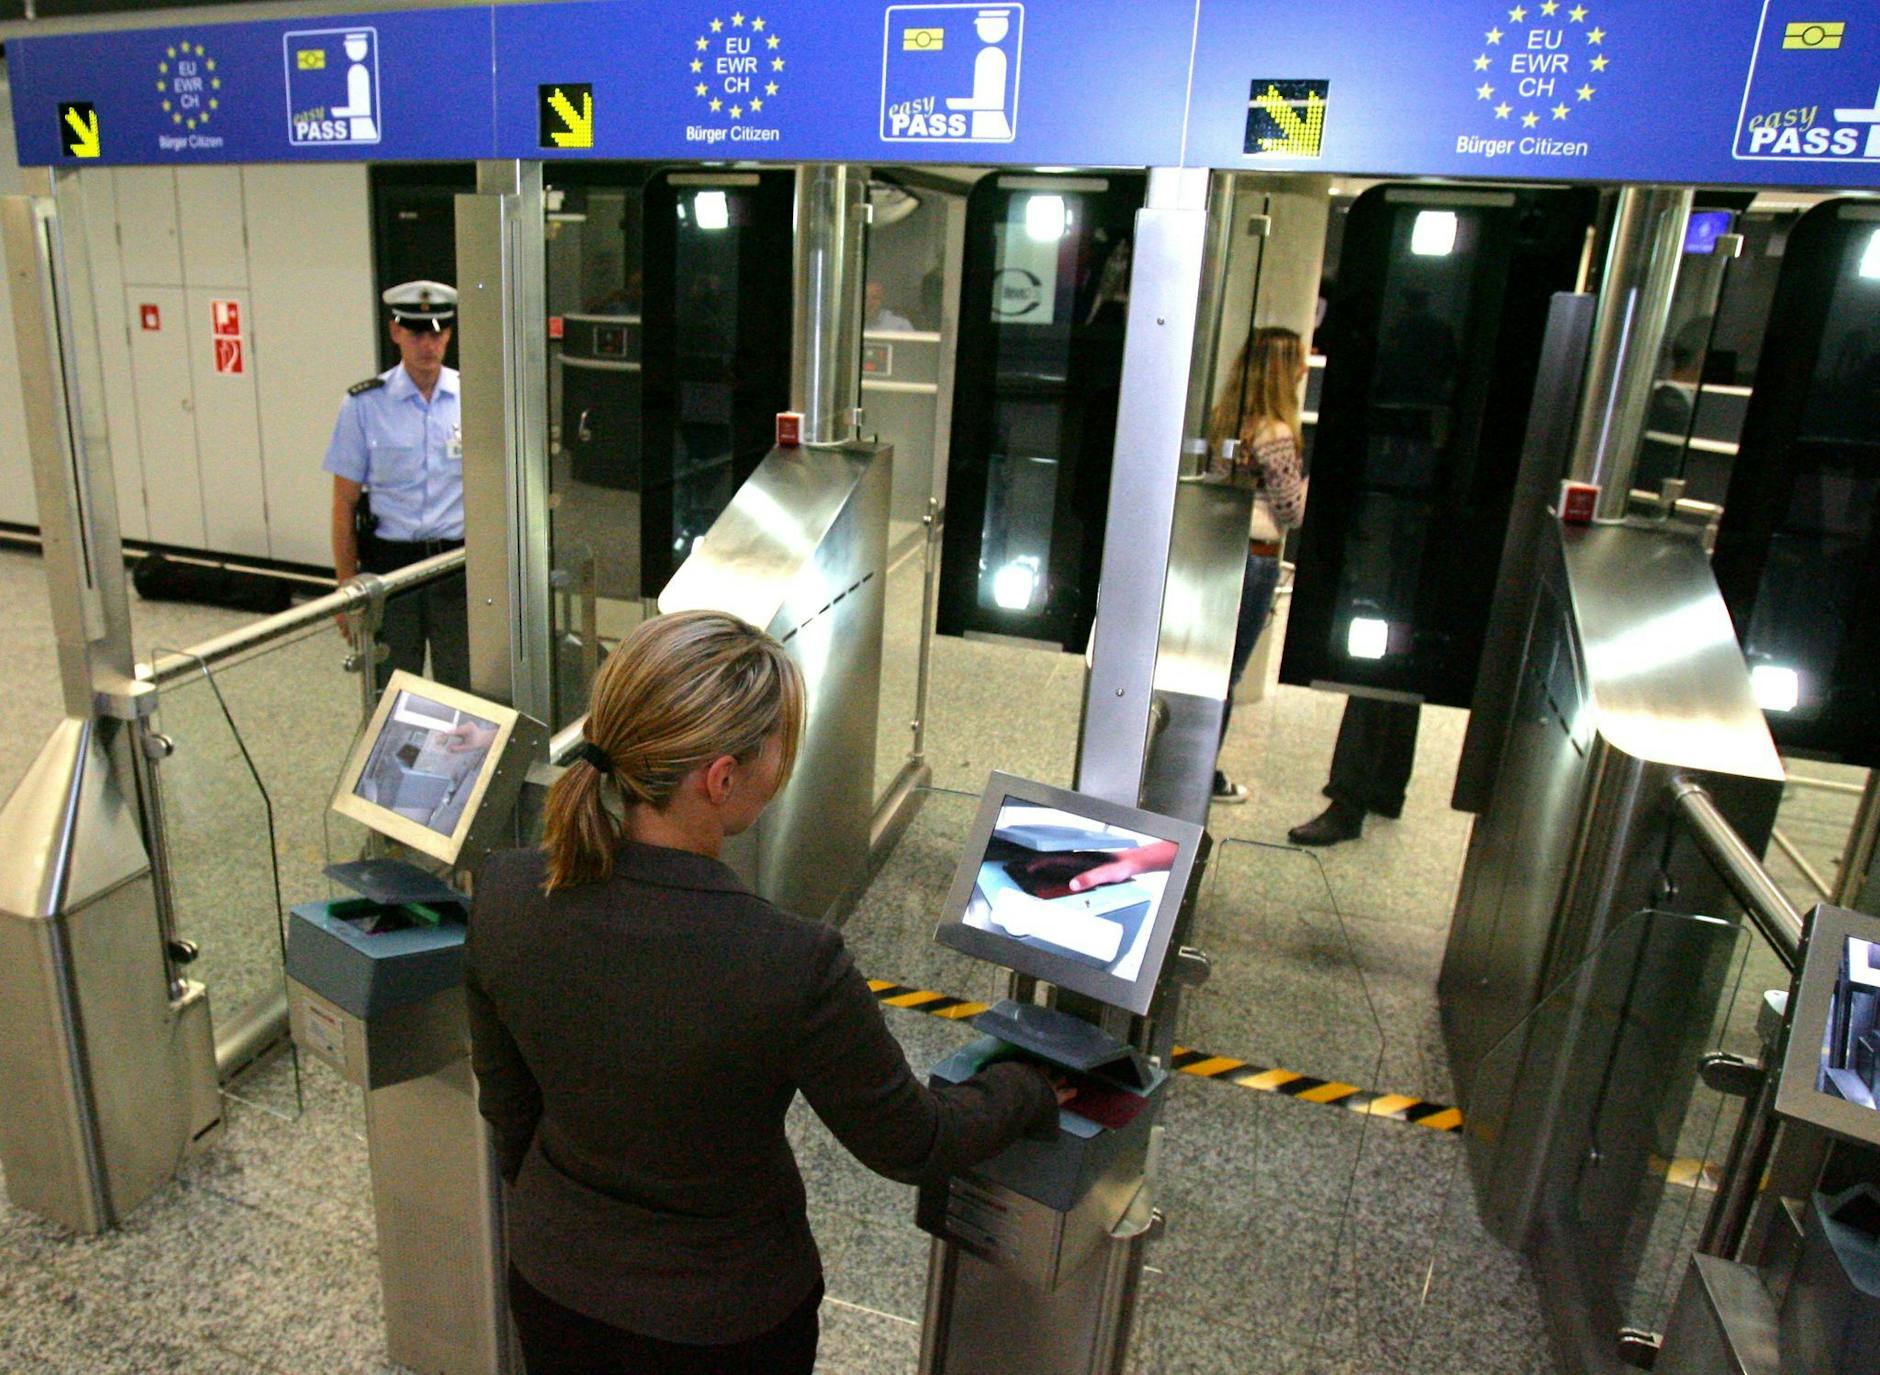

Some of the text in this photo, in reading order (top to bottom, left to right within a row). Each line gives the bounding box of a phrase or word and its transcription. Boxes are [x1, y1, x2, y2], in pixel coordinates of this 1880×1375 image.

[726, 37, 750, 54] EU
[1527, 30, 1563, 49] EU
[179, 61, 197, 76] EU
[716, 56, 758, 74] EWR
[1510, 53, 1569, 74] EWR
[174, 77, 203, 93] EWR
[724, 76, 750, 93] CH
[1519, 77, 1555, 97] CH
[181, 93, 199, 109] CH
[889, 96, 935, 119] easy
[891, 113, 967, 137] PASS
[1748, 105, 1818, 132] easy
[296, 120, 347, 141] PASS
[686, 125, 780, 144] Bürger Citizen
[1456, 135, 1588, 157] Bürger Citizen
[1749, 127, 1859, 155] PASS
